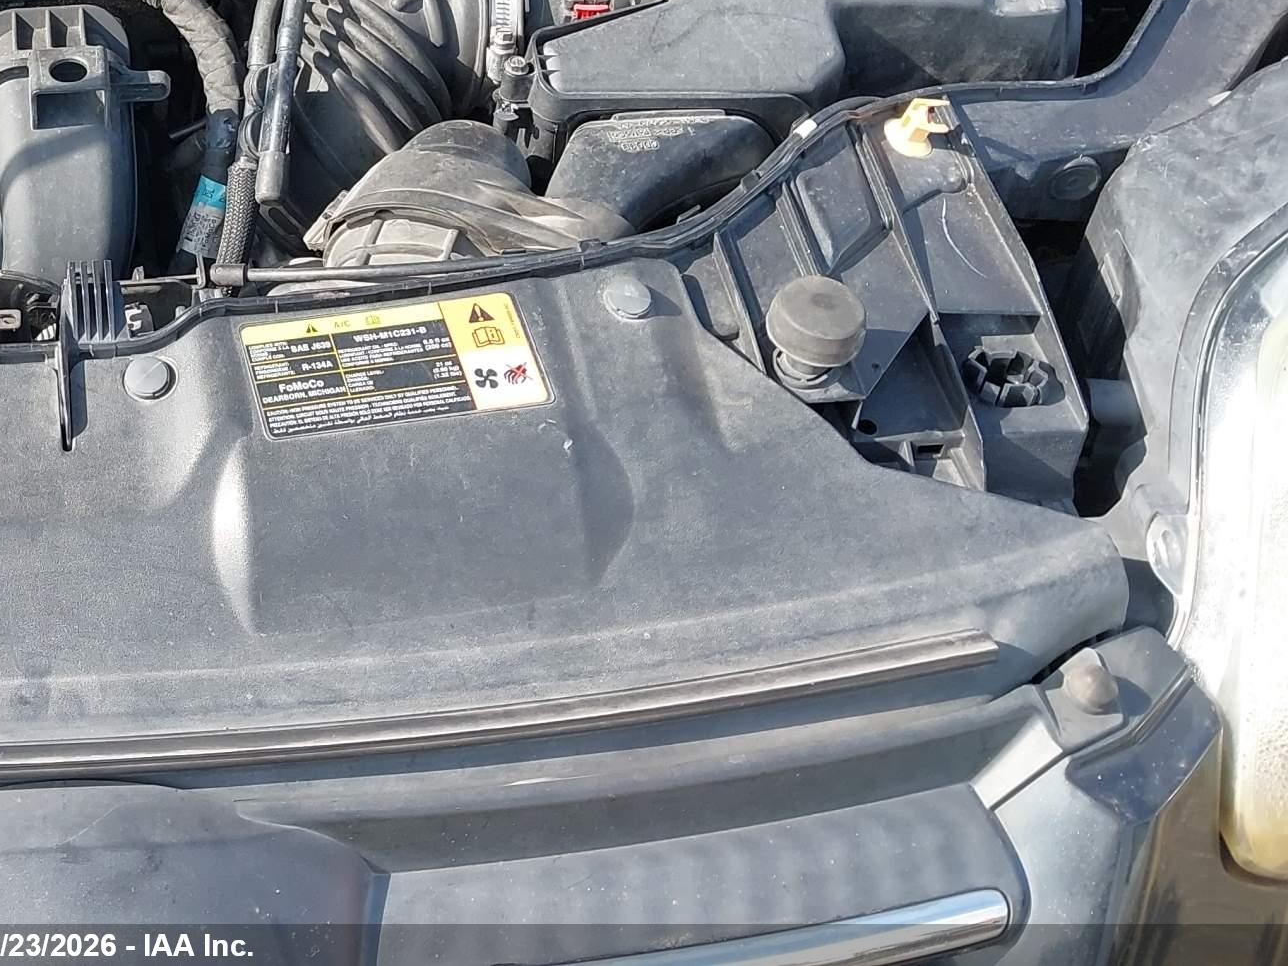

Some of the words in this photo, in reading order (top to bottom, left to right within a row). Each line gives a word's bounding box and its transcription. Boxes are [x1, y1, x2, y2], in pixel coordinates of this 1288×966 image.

[353, 326, 427, 342] WSH-M1C231-B
[291, 344, 309, 352] SAE
[310, 341, 330, 349] J639
[301, 360, 333, 371] R-134A
[278, 379, 324, 392] FoMoCo
[263, 392, 307, 403] DEARBORN,
[308, 387, 345, 396] MICHIGAN
